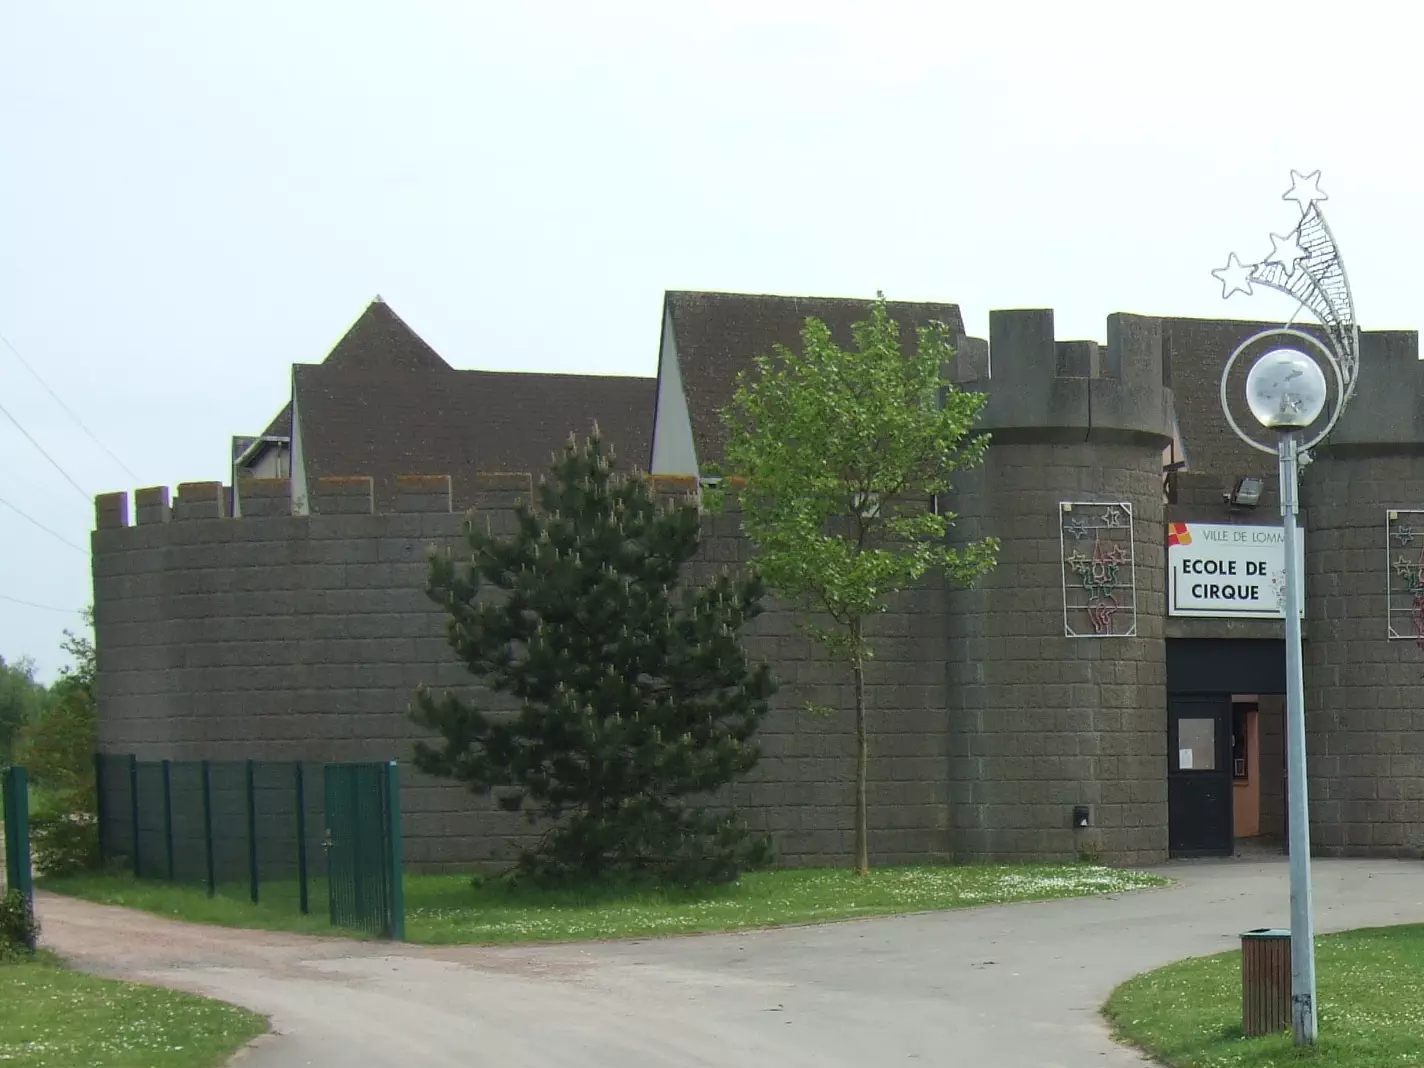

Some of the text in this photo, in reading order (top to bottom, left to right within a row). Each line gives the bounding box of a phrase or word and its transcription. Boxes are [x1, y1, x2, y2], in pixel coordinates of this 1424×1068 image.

[1202, 530, 1229, 542] VILLE
[1233, 531, 1248, 542] DE
[1182, 559, 1267, 576] ECOLE DE
[1191, 584, 1259, 600] CIRQUE
